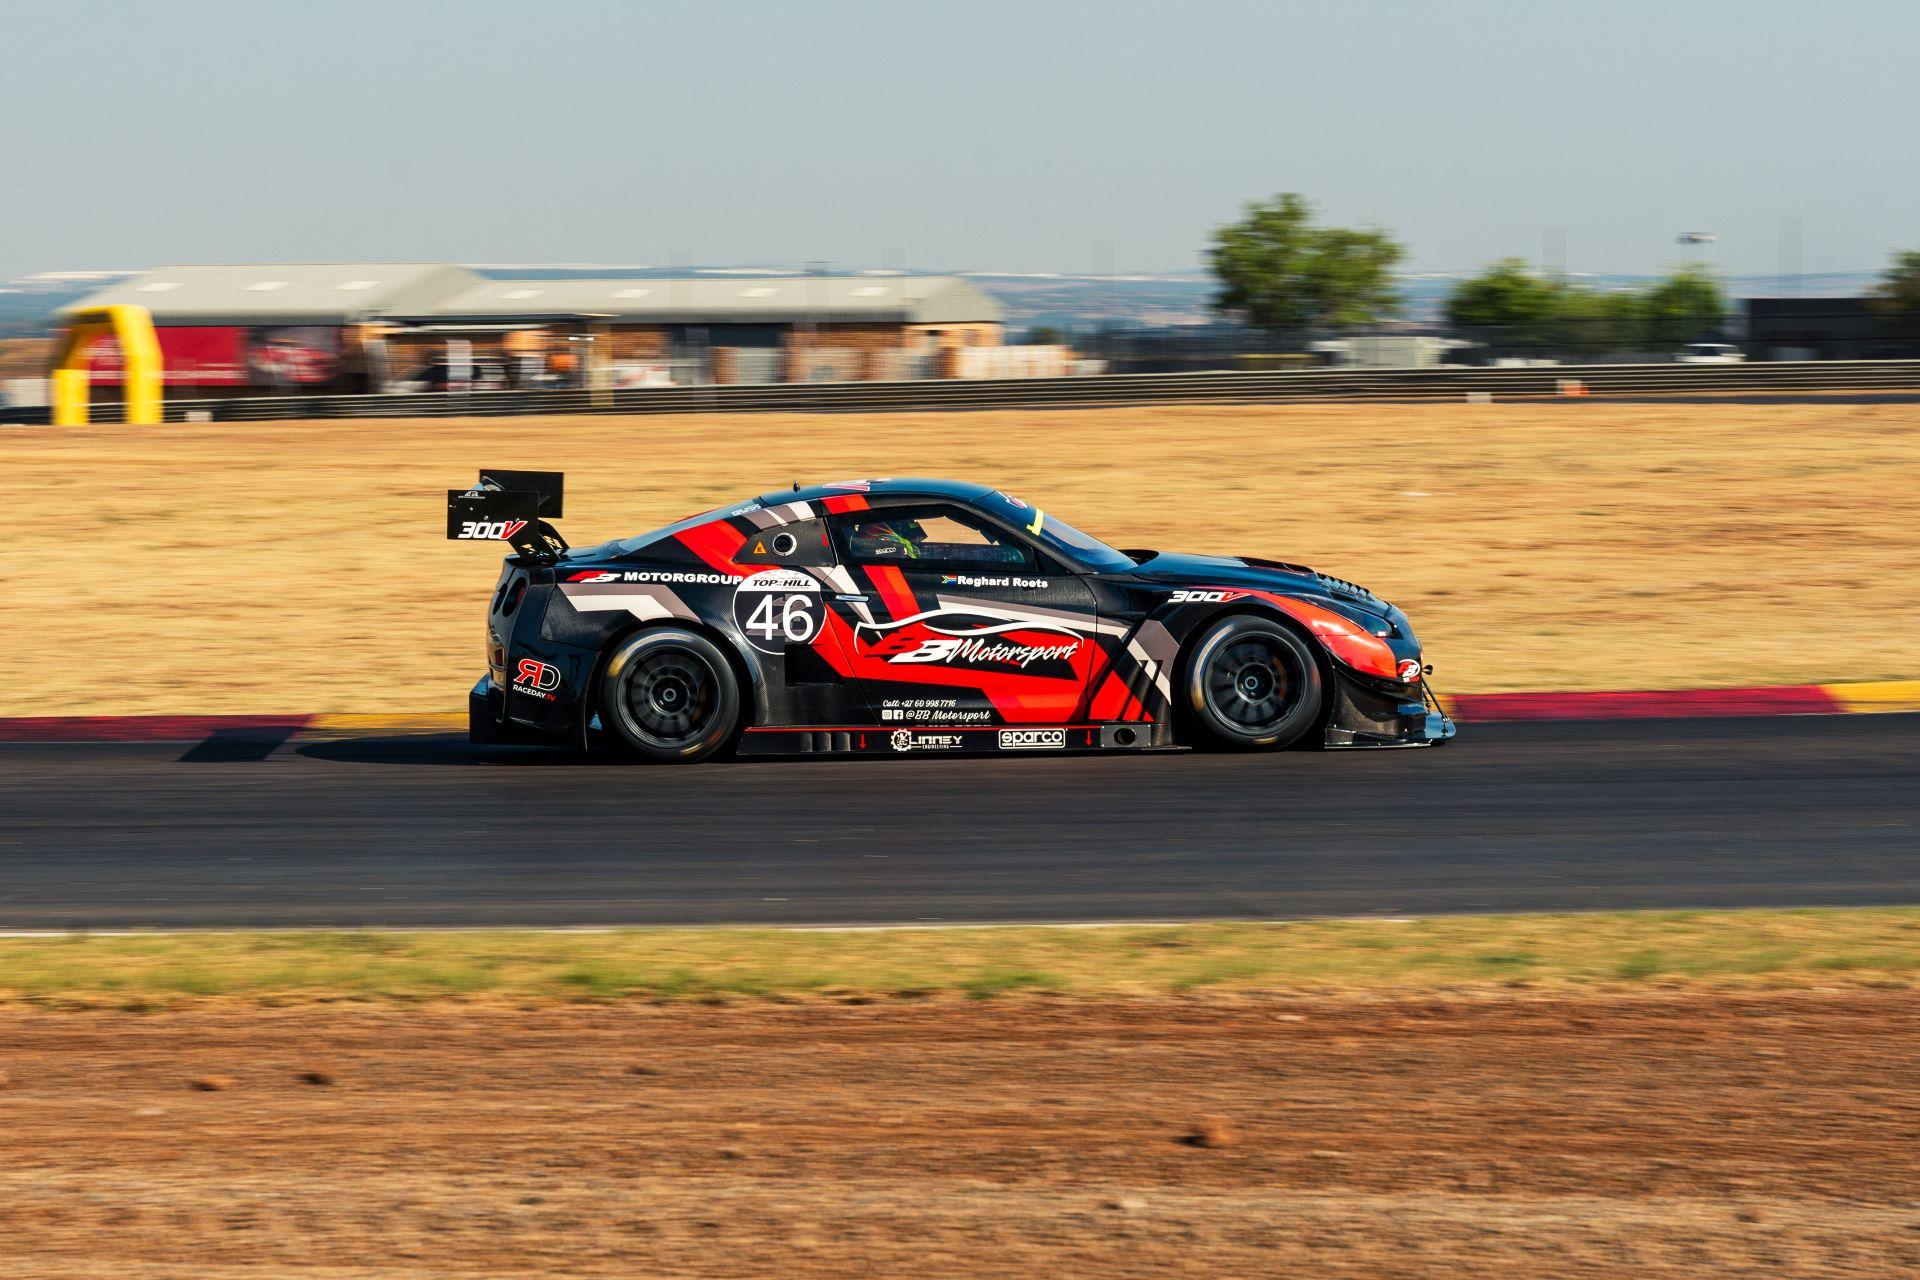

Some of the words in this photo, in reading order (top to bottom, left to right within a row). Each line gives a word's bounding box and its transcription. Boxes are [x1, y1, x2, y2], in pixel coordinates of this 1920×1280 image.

[457, 520, 528, 540] 300V
[624, 572, 744, 586] MOTORGROUP
[753, 579, 779, 587] TOP
[782, 579, 812, 587] HILL
[957, 575, 1010, 587] Reghard
[1012, 577, 1049, 588] Roets
[1167, 590, 1251, 603] 300V
[745, 594, 814, 642] 46
[945, 638, 1079, 669] Motorsport
[901, 699, 913, 708] +27
[914, 699, 925, 708] 60
[925, 699, 940, 708] 998
[905, 709, 931, 720] @BB
[932, 710, 990, 722] Motorsport
[909, 736, 962, 744] LINNEY
[1001, 731, 1063, 747] sparco
